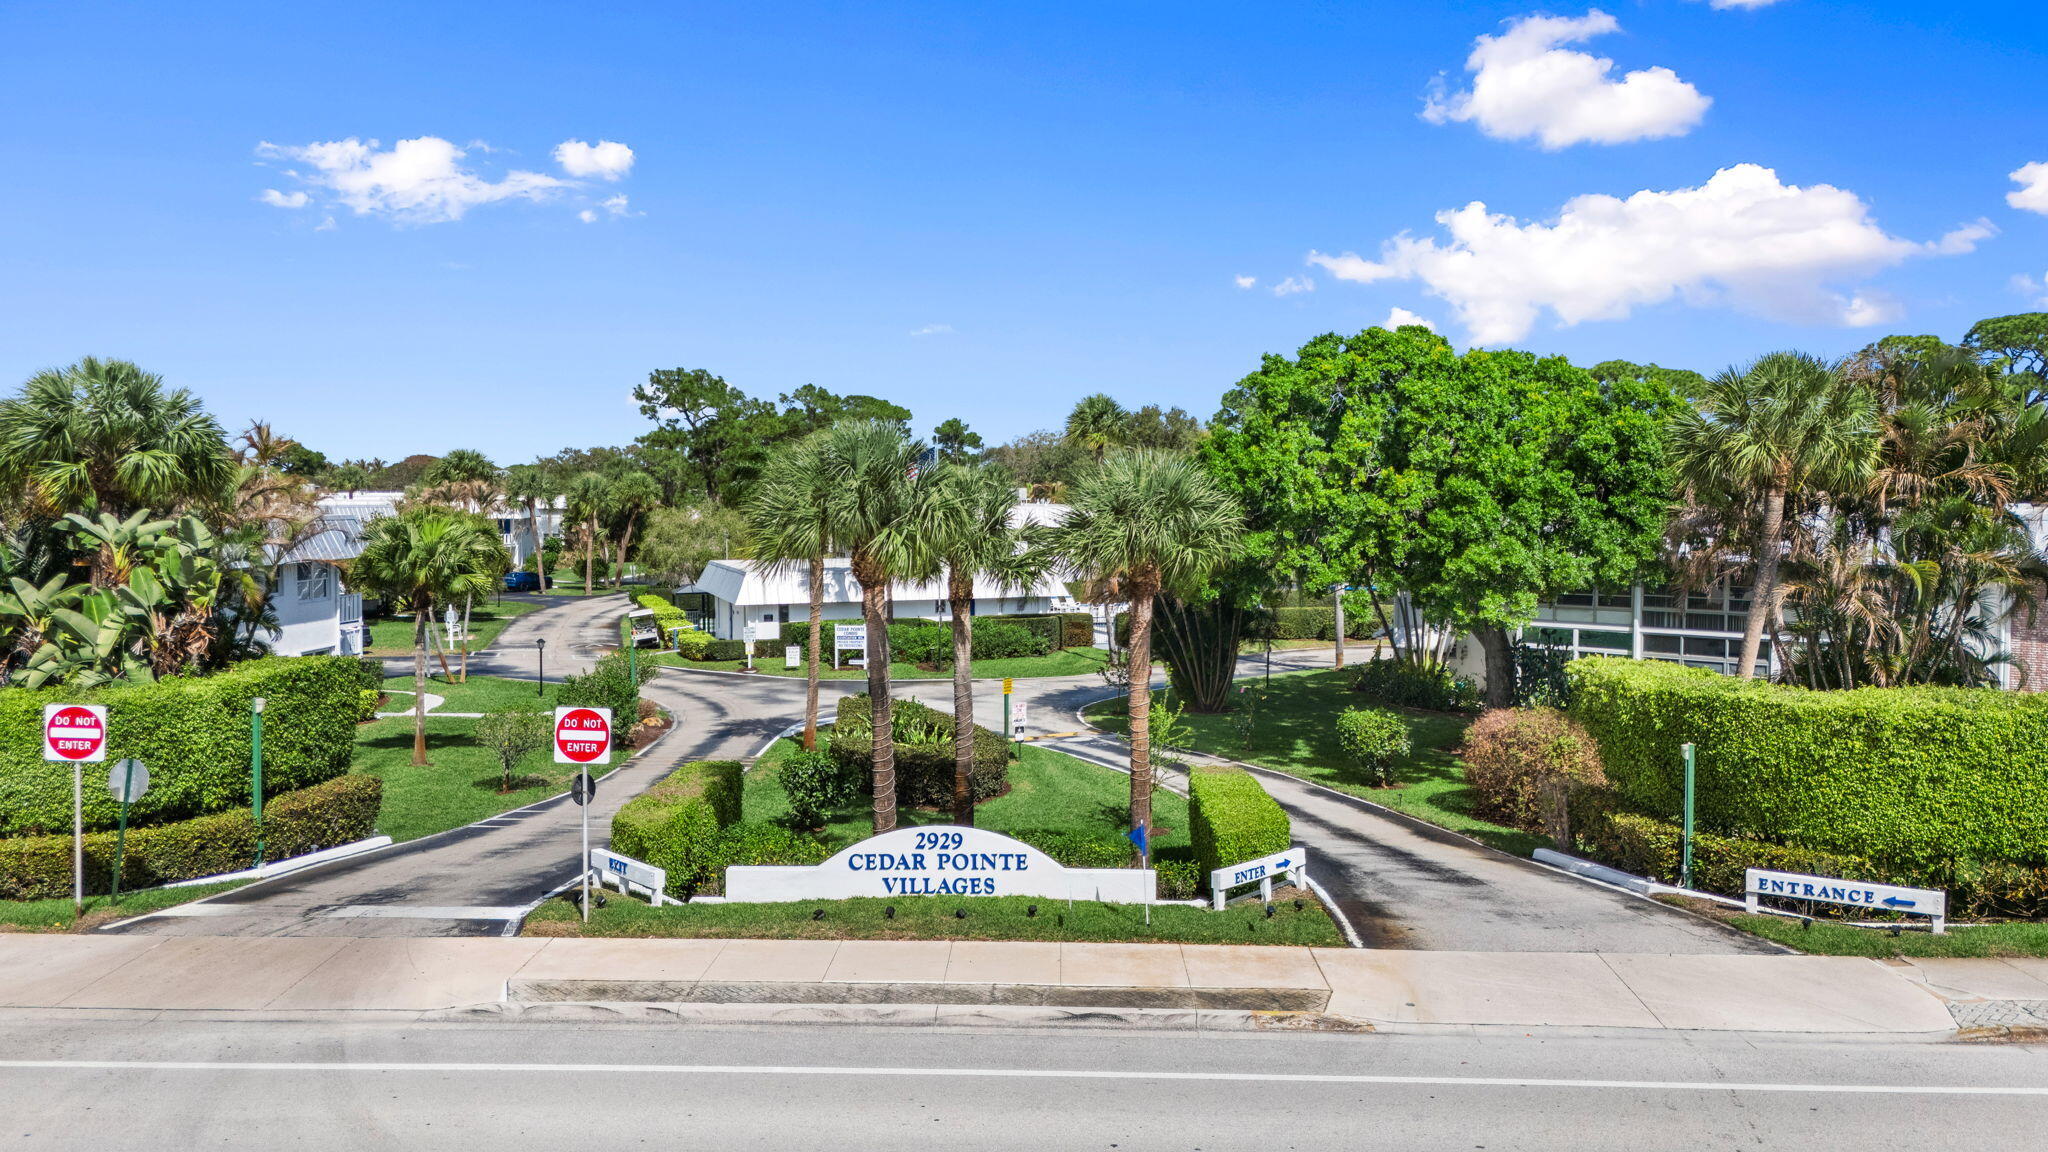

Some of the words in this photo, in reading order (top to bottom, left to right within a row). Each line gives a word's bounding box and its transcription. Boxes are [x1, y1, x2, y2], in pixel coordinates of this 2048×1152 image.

[55, 716, 70, 726] DO
[75, 716, 96, 726] NOT
[564, 718, 578, 728] DO
[583, 718, 602, 729] NOT
[58, 740, 92, 750] ENTER
[567, 742, 598, 752] ENTER
[915, 832, 963, 850] 2929
[608, 857, 628, 876] EXIT
[848, 853, 926, 871] CEDAR
[937, 853, 1029, 871] POINTE
[1234, 865, 1266, 884] ENTER
[882, 877, 995, 894] VILLAGES
[1758, 877, 1875, 904] ENTRANCE
